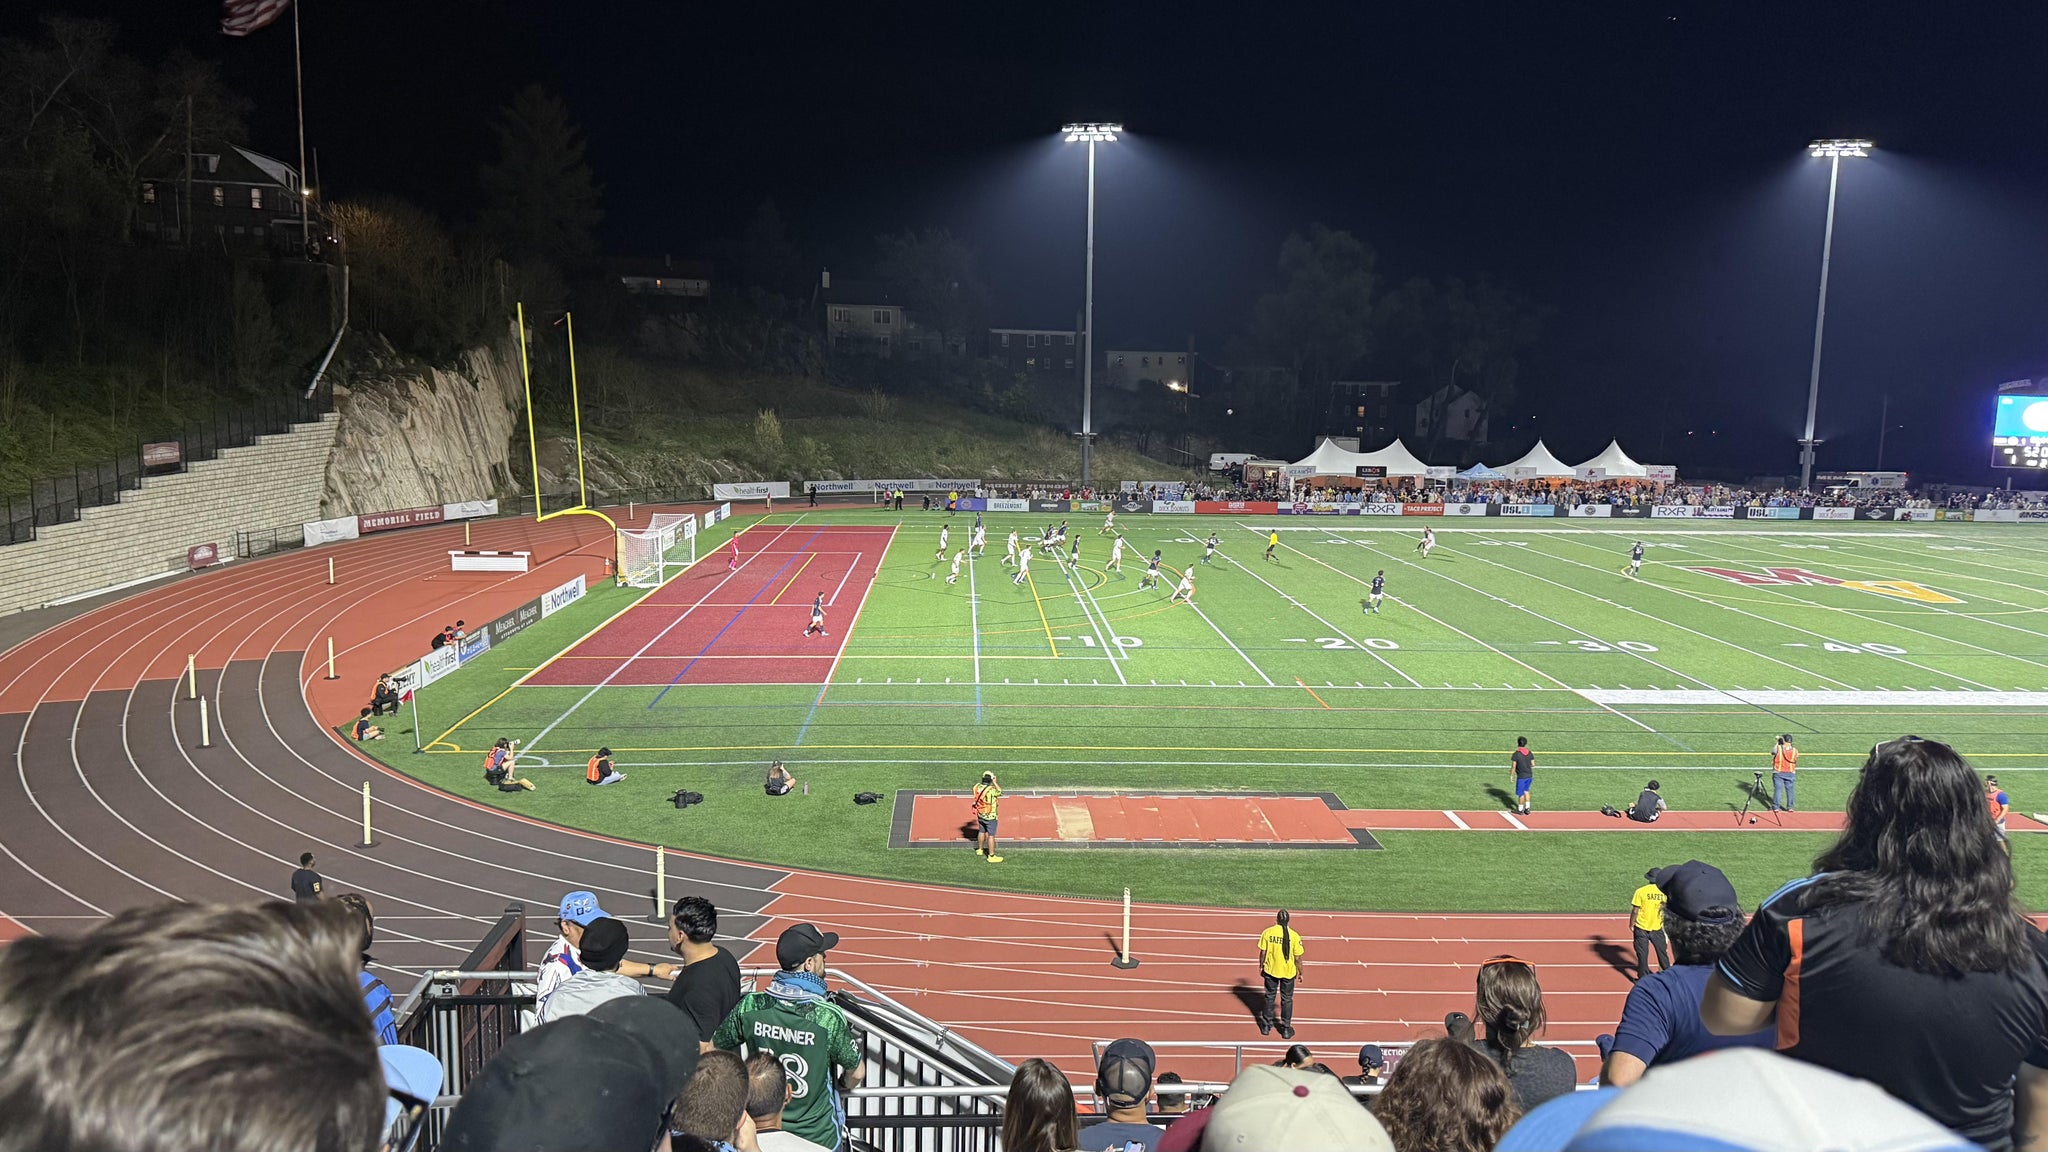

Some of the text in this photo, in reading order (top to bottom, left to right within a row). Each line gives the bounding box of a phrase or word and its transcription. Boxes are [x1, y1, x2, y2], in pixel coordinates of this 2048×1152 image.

[814, 482, 853, 491] Northwell
[875, 481, 914, 490] Northwell
[935, 481, 976, 490] Northwell
[1366, 504, 1396, 513] RXR
[1502, 505, 1521, 514] USL
[1658, 507, 1687, 516] RXR
[363, 511, 440, 528] MEMORIAL FIELD
[551, 580, 579, 610] Northwell
[1078, 636, 1143, 648] 10
[1314, 637, 1399, 649] 20
[1567, 640, 1659, 652] 30
[1823, 642, 1908, 654] 40
[1646, 893, 1666, 901] SAFET
[754, 1021, 816, 1046] BRENNER
